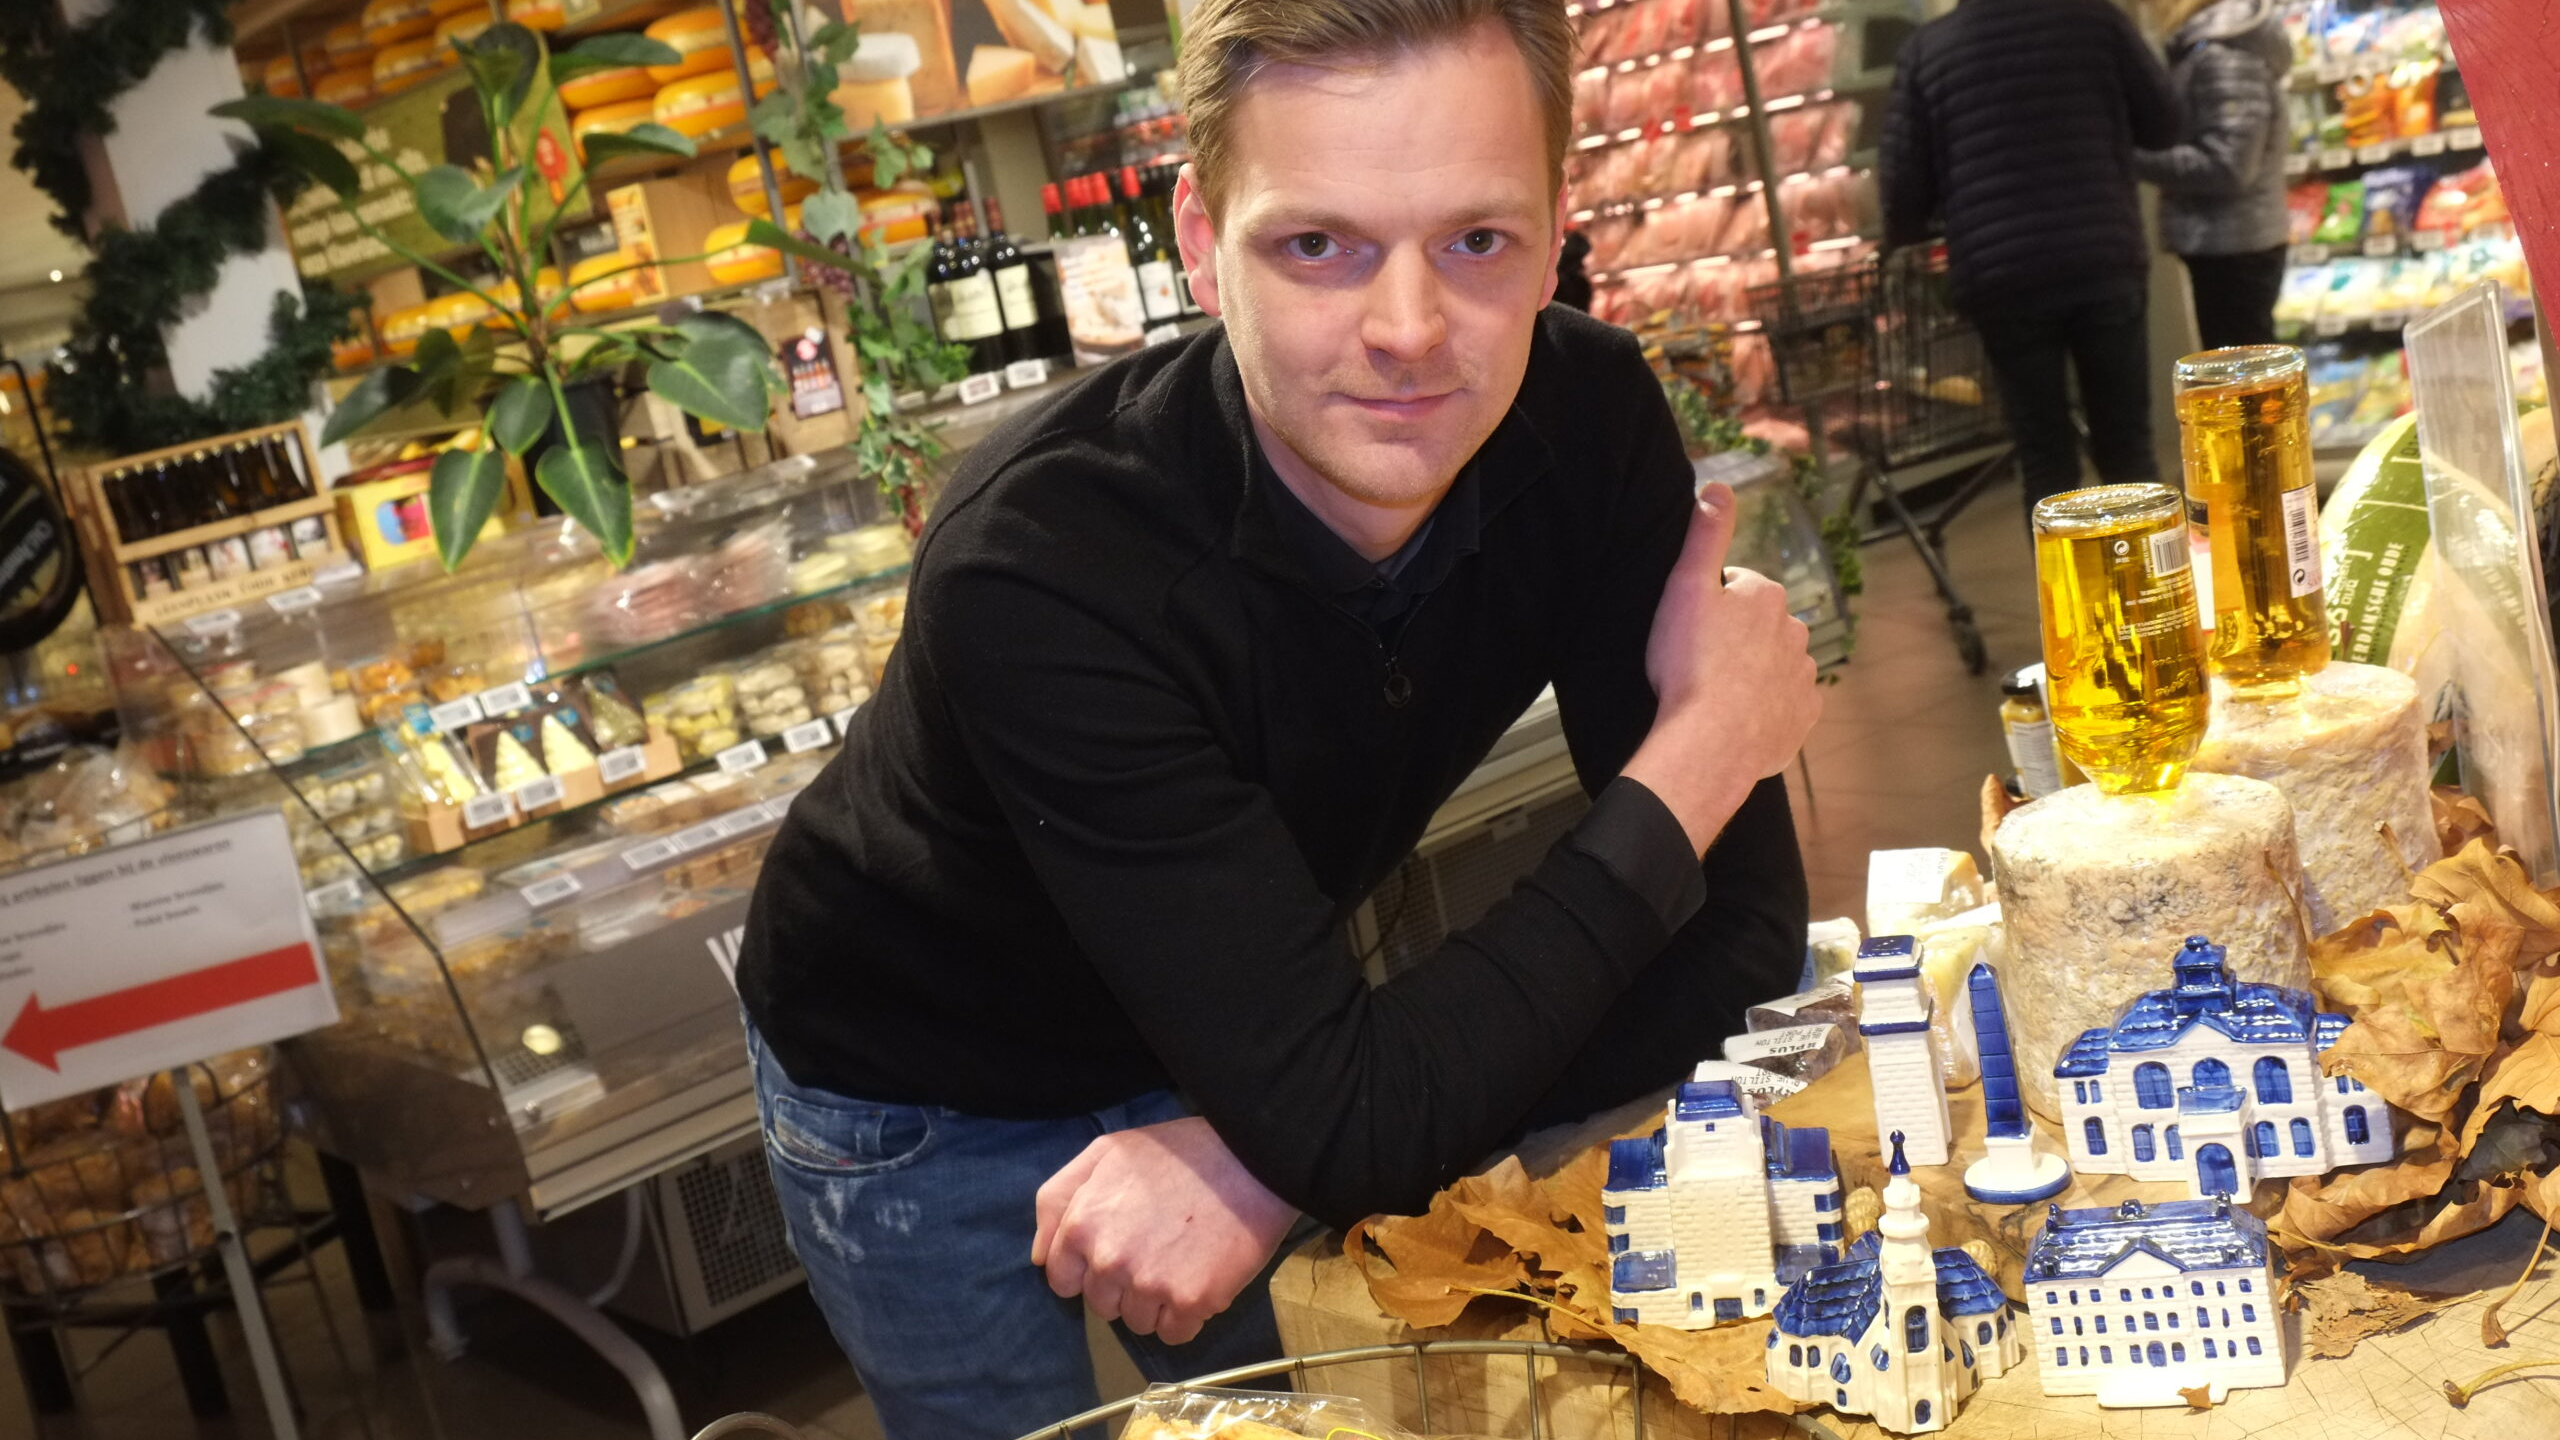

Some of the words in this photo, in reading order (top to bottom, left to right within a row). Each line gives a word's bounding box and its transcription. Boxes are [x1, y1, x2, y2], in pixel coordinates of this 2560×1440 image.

[2377, 542, 2405, 576] OUDE
[1755, 1036, 1794, 1047] STILTON
[1769, 1045, 1804, 1055] PLUS
[1731, 1075, 1772, 1085] STILTON
